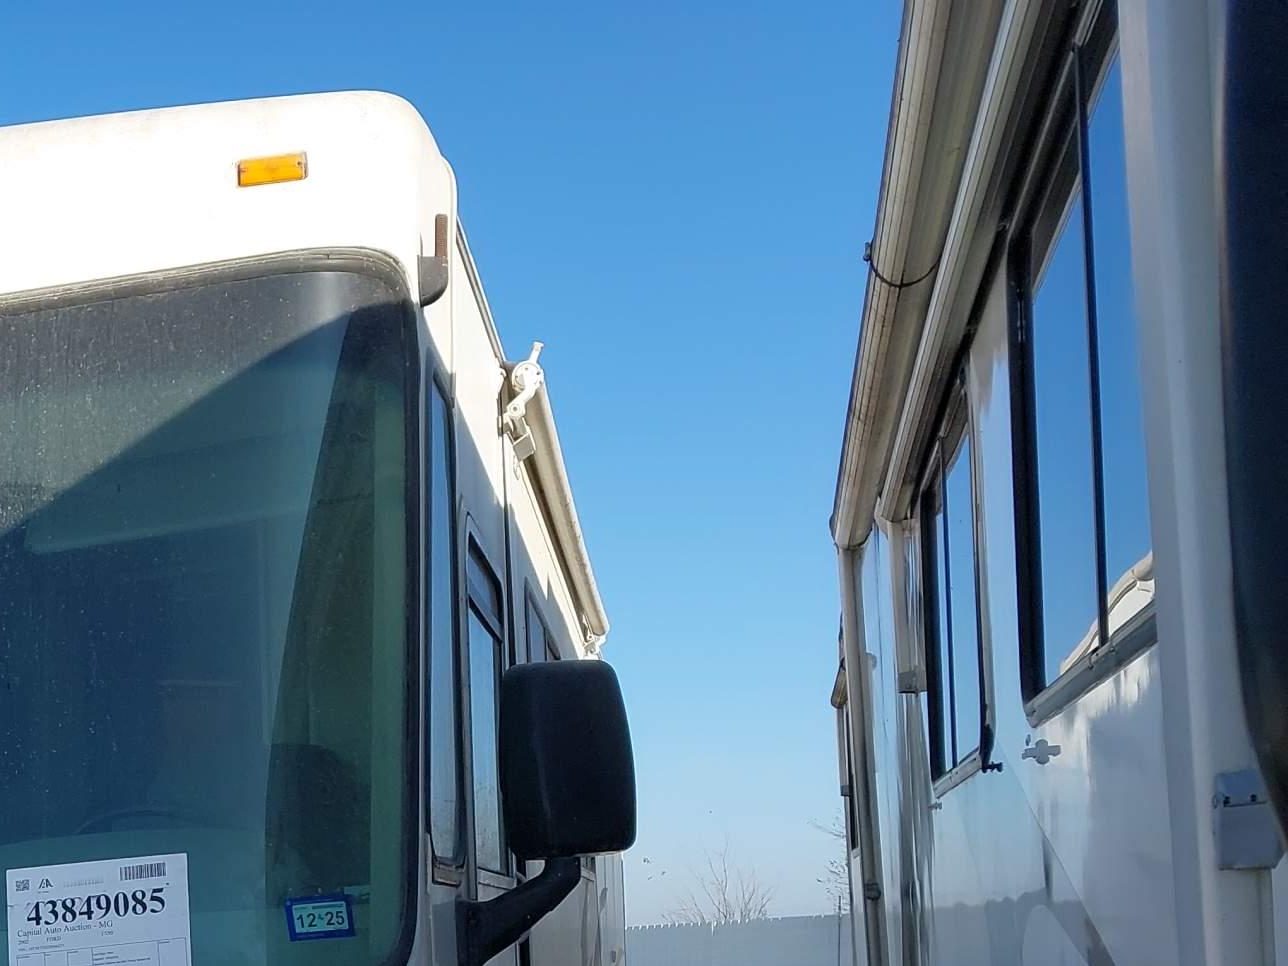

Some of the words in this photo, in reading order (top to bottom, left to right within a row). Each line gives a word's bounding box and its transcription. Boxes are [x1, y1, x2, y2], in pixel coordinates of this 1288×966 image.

[26, 887, 166, 926] 43849085
[17, 928, 42, 940] Capital
[44, 927, 62, 936] Auto
[64, 922, 92, 933] Auction
